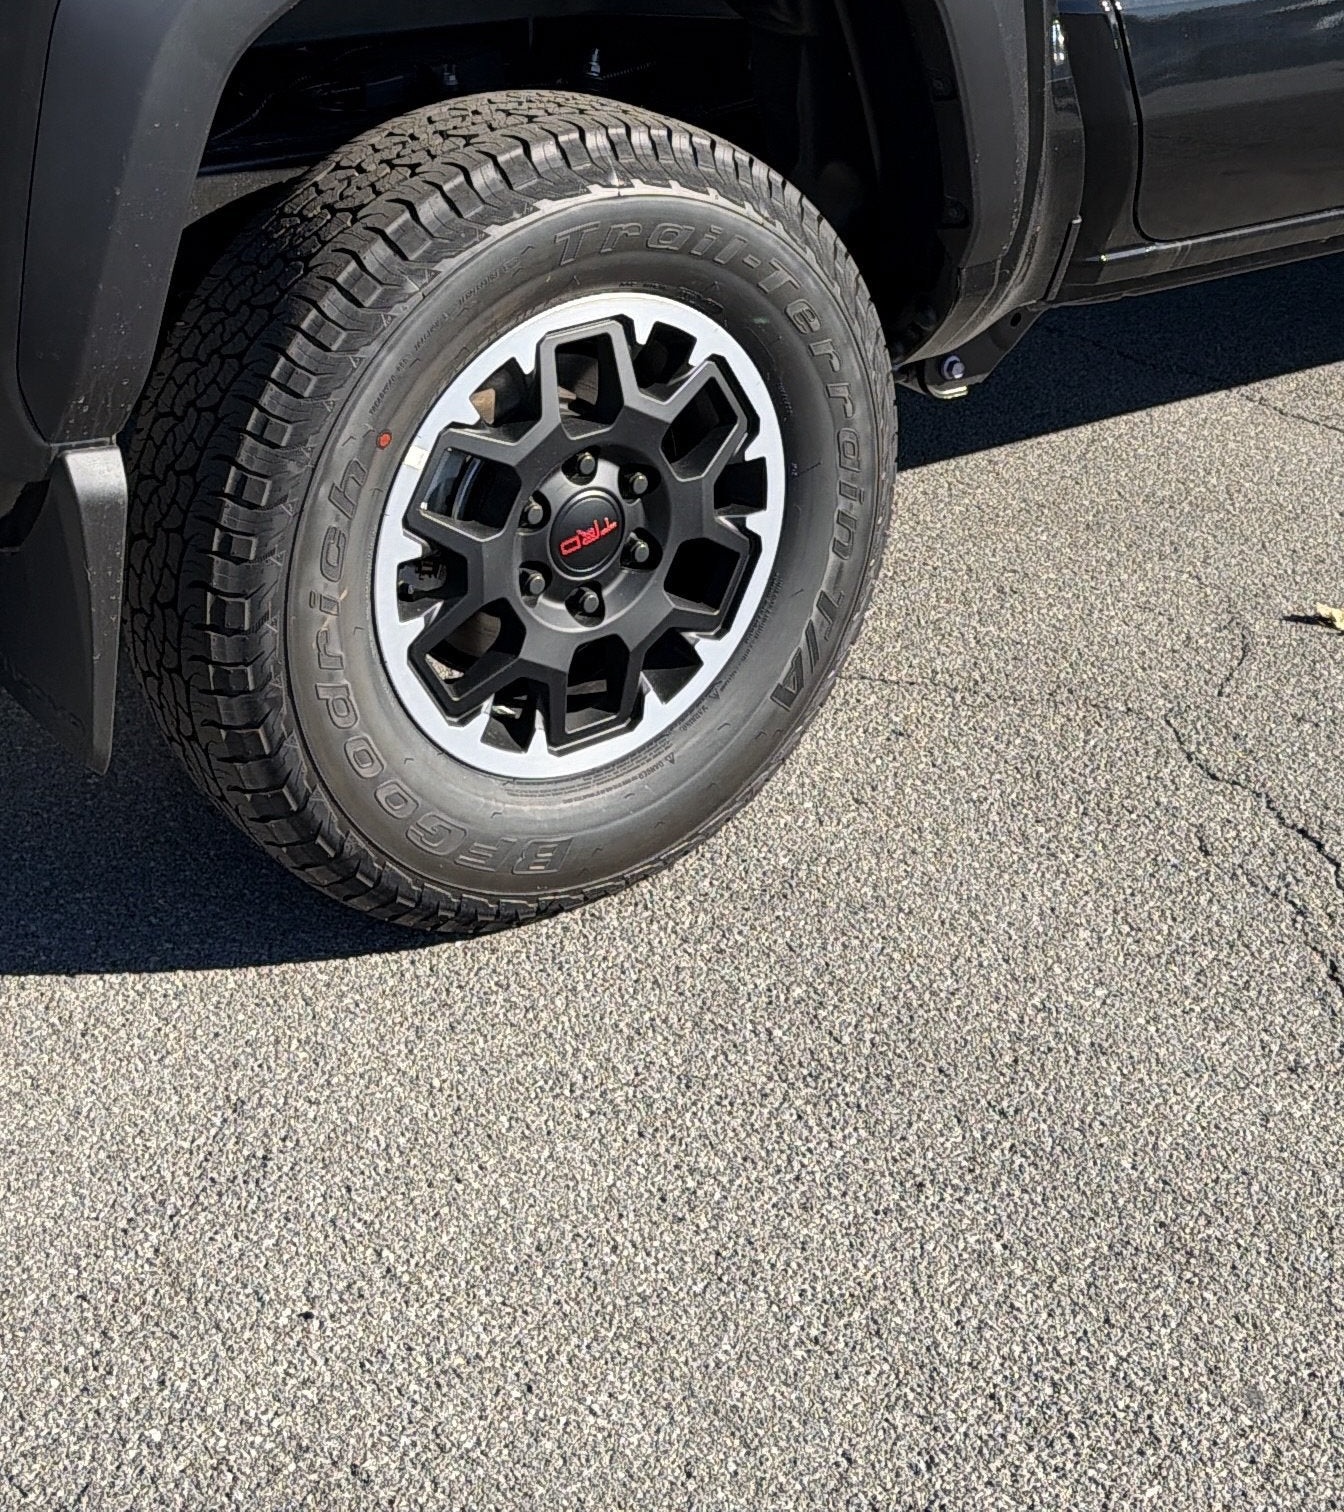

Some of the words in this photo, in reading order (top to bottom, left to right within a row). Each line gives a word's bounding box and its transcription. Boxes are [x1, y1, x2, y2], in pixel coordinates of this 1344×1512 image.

[553, 220, 866, 561] Trail-Terrain
[560, 517, 618, 556] TRD
[309, 460, 574, 875] BFGoodrich
